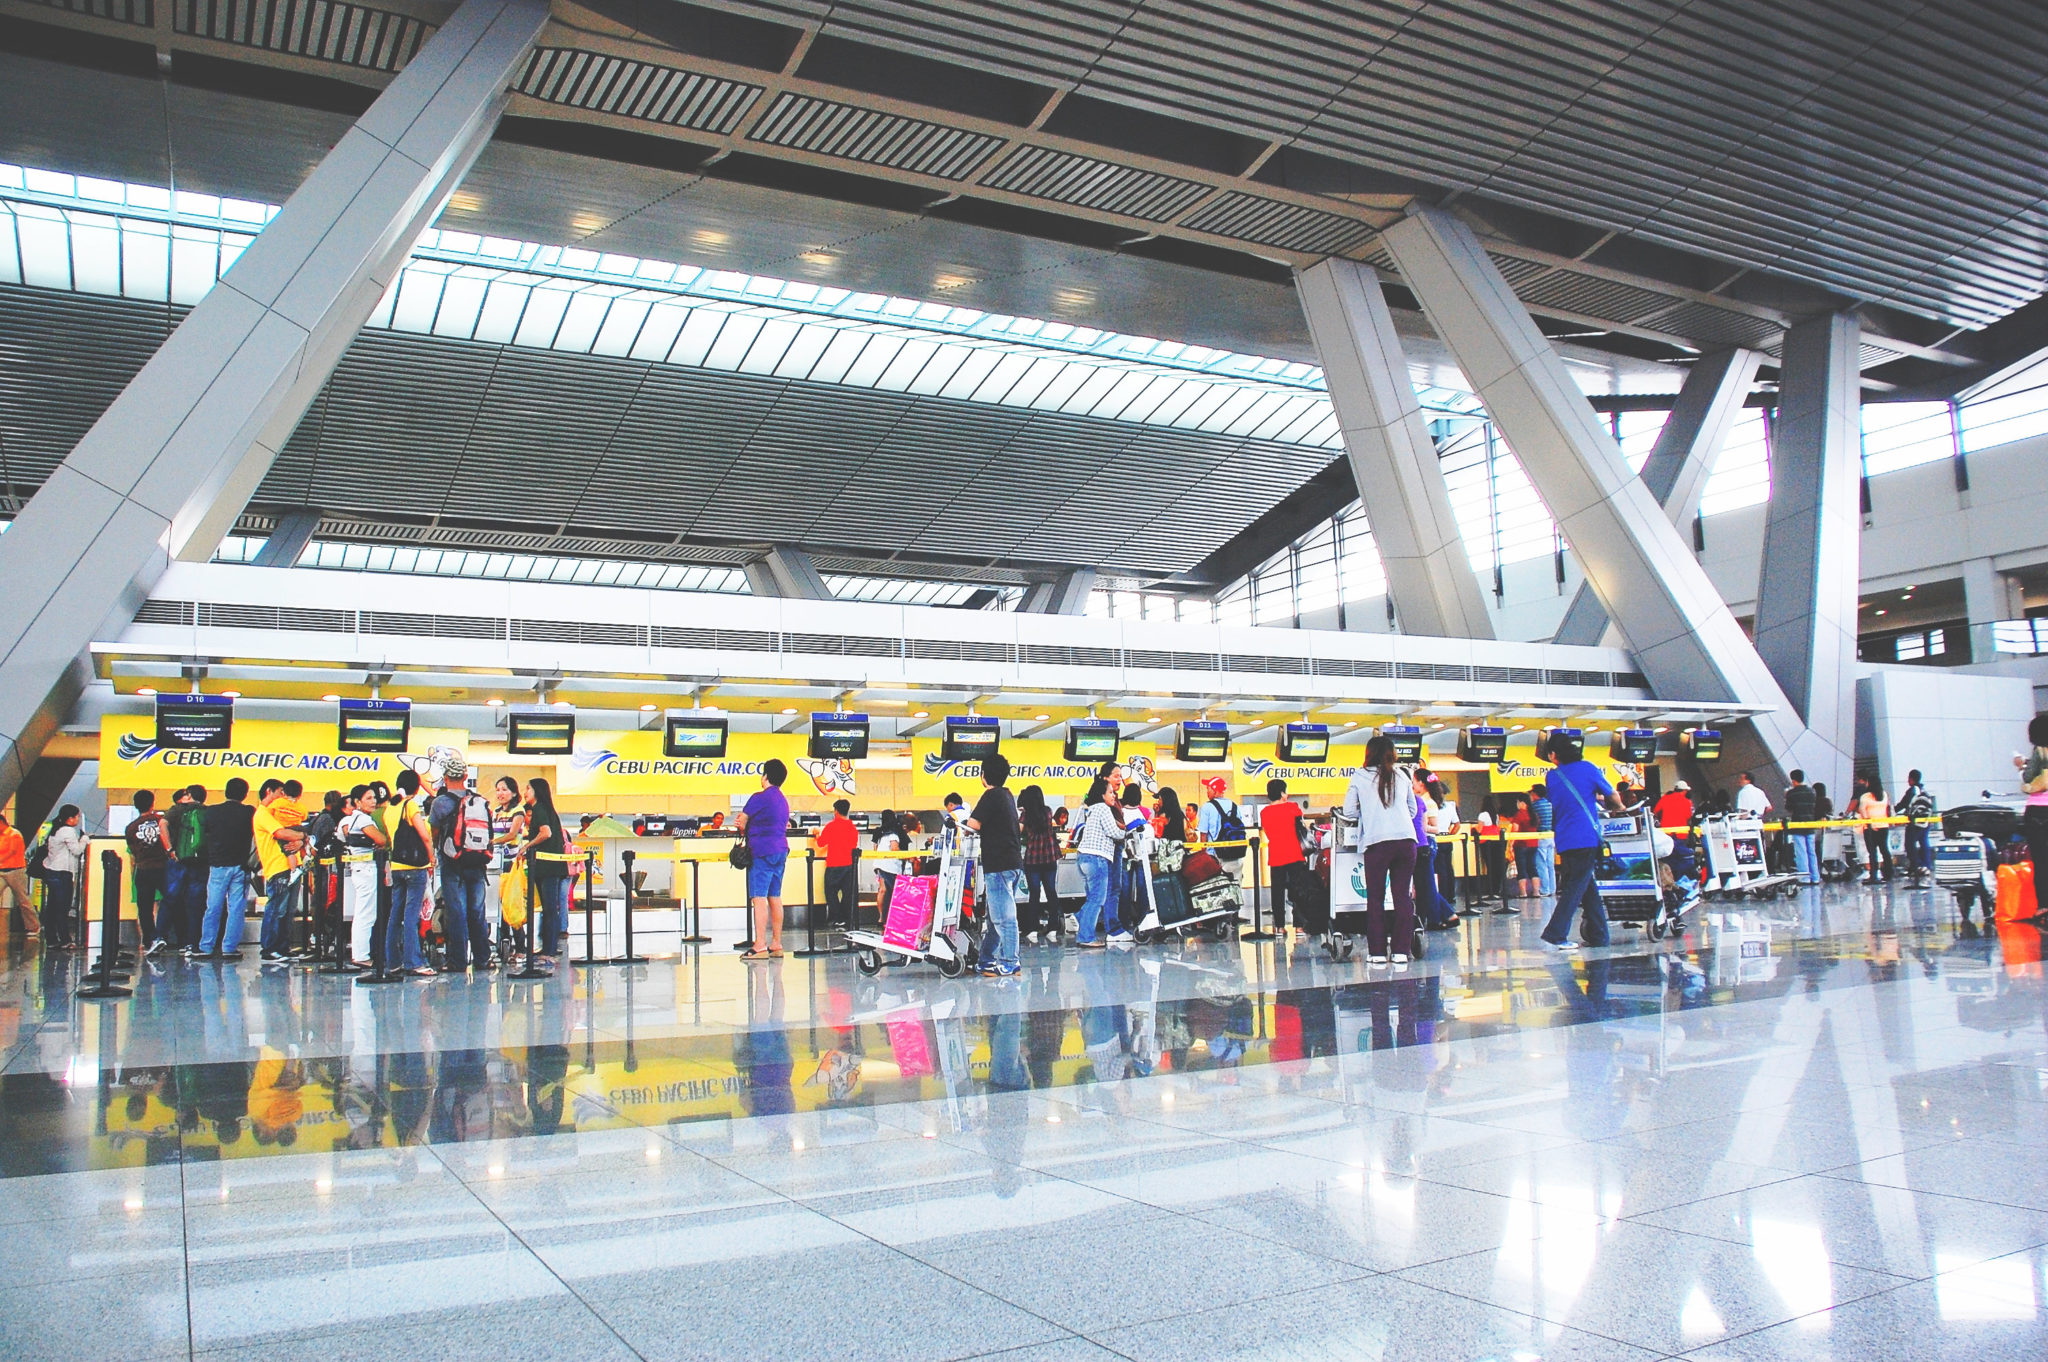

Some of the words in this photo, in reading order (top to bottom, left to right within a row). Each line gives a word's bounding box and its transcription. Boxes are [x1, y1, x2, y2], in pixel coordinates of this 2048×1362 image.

[163, 750, 216, 766] CEBU
[221, 753, 294, 768] PACIFIC
[298, 755, 379, 771] AIR.COM
[607, 761, 649, 774] CEBU
[654, 762, 713, 774] PACIFIC
[716, 762, 765, 775] AIR.CO
[954, 766, 980, 777] CEB
[1009, 766, 1041, 777] CIFIC
[1044, 766, 1097, 777] AIR.COM
[1267, 767, 1295, 778] CEBU
[1298, 767, 1336, 778] PACIFIC
[1339, 767, 1356, 777] AIR
[1516, 767, 1537, 776] CEBU
[1604, 823, 1632, 831] SMART
